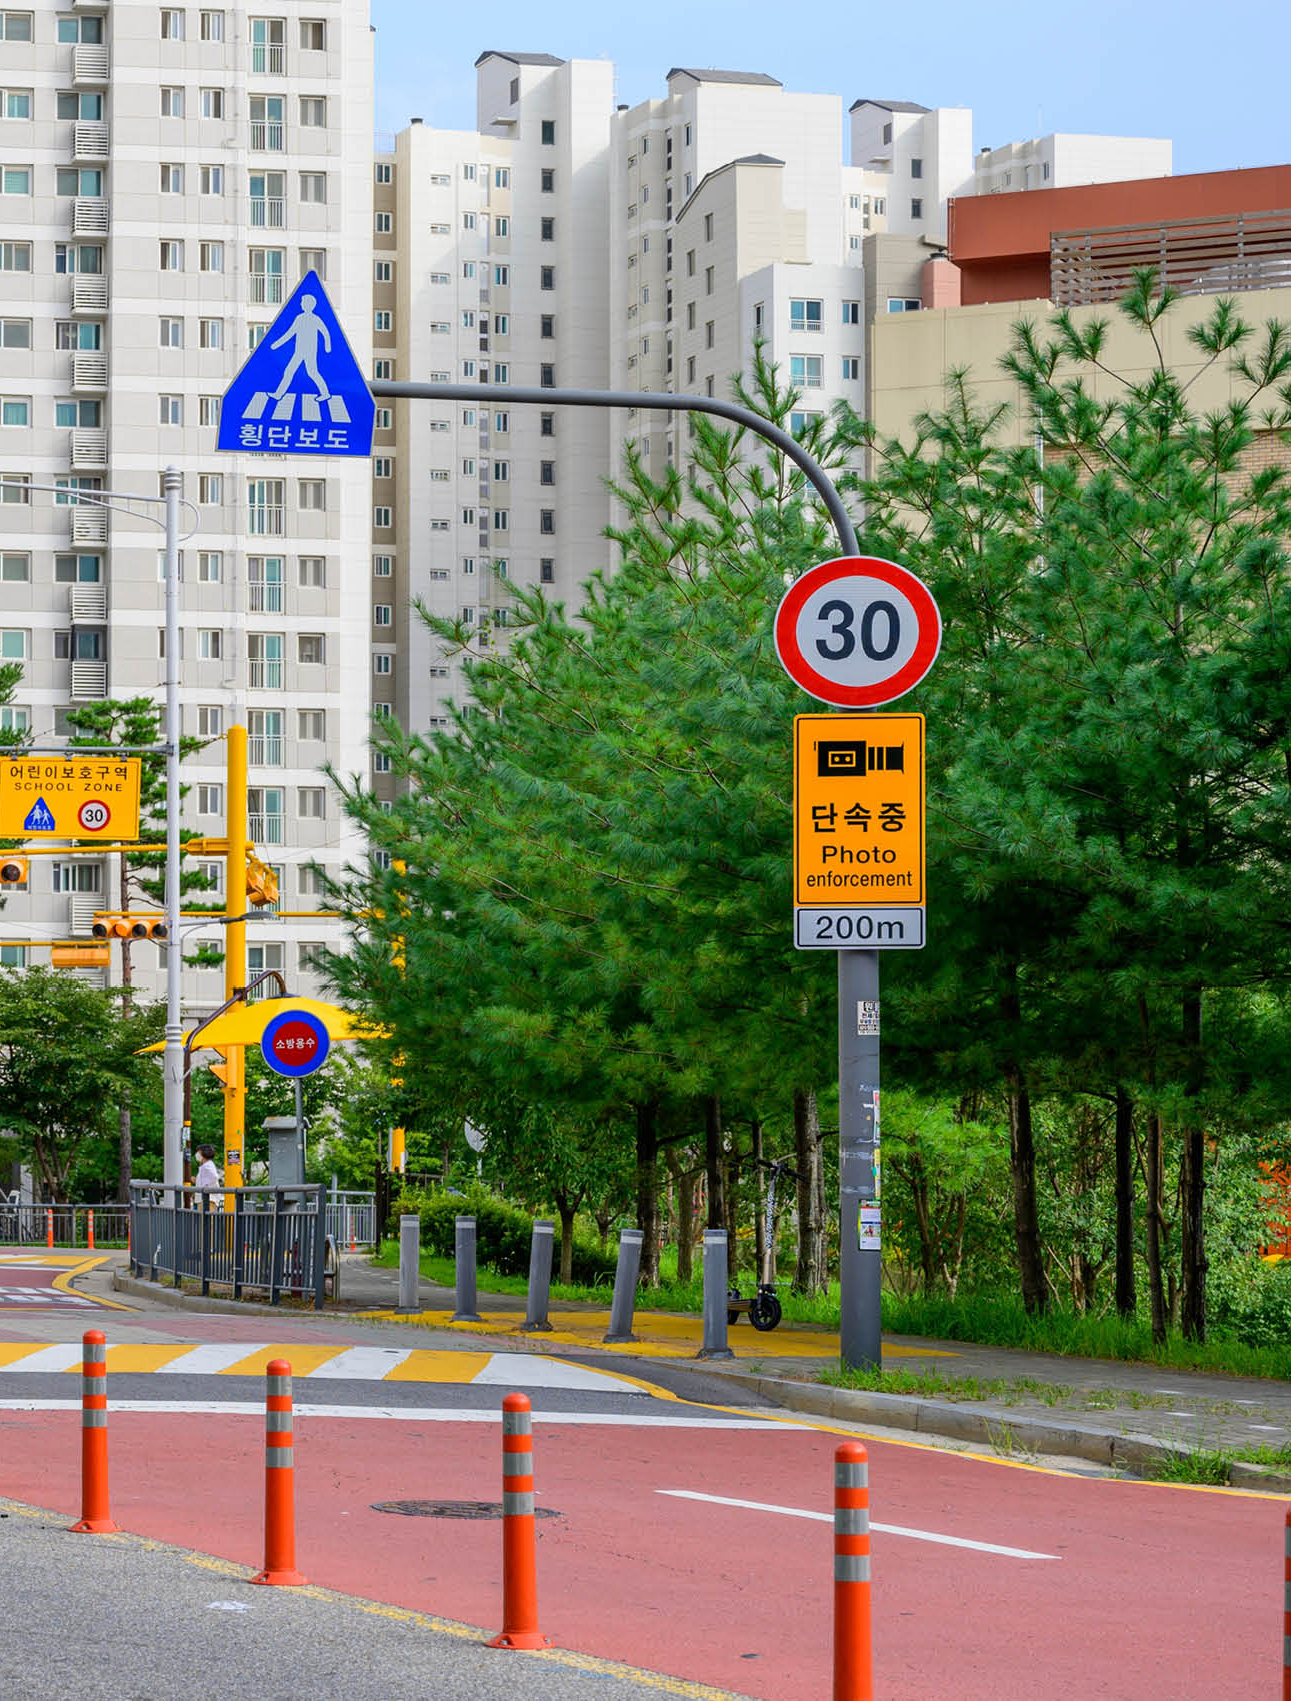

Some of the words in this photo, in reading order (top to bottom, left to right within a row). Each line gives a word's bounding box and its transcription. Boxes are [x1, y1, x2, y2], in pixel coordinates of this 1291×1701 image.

[239, 424, 349, 449] 횡단보도
[815, 599, 901, 662] 30
[10, 765, 128, 781] 어린이보호구역
[14, 782, 74, 792] SCHOOL
[84, 783, 123, 792] ZONE
[85, 809, 104, 823] 30
[811, 802, 907, 833] 단속중
[821, 844, 897, 864] Photo
[806, 870, 913, 888] enforcement
[816, 915, 904, 940] 200m
[275, 1037, 316, 1050] 소방용수
